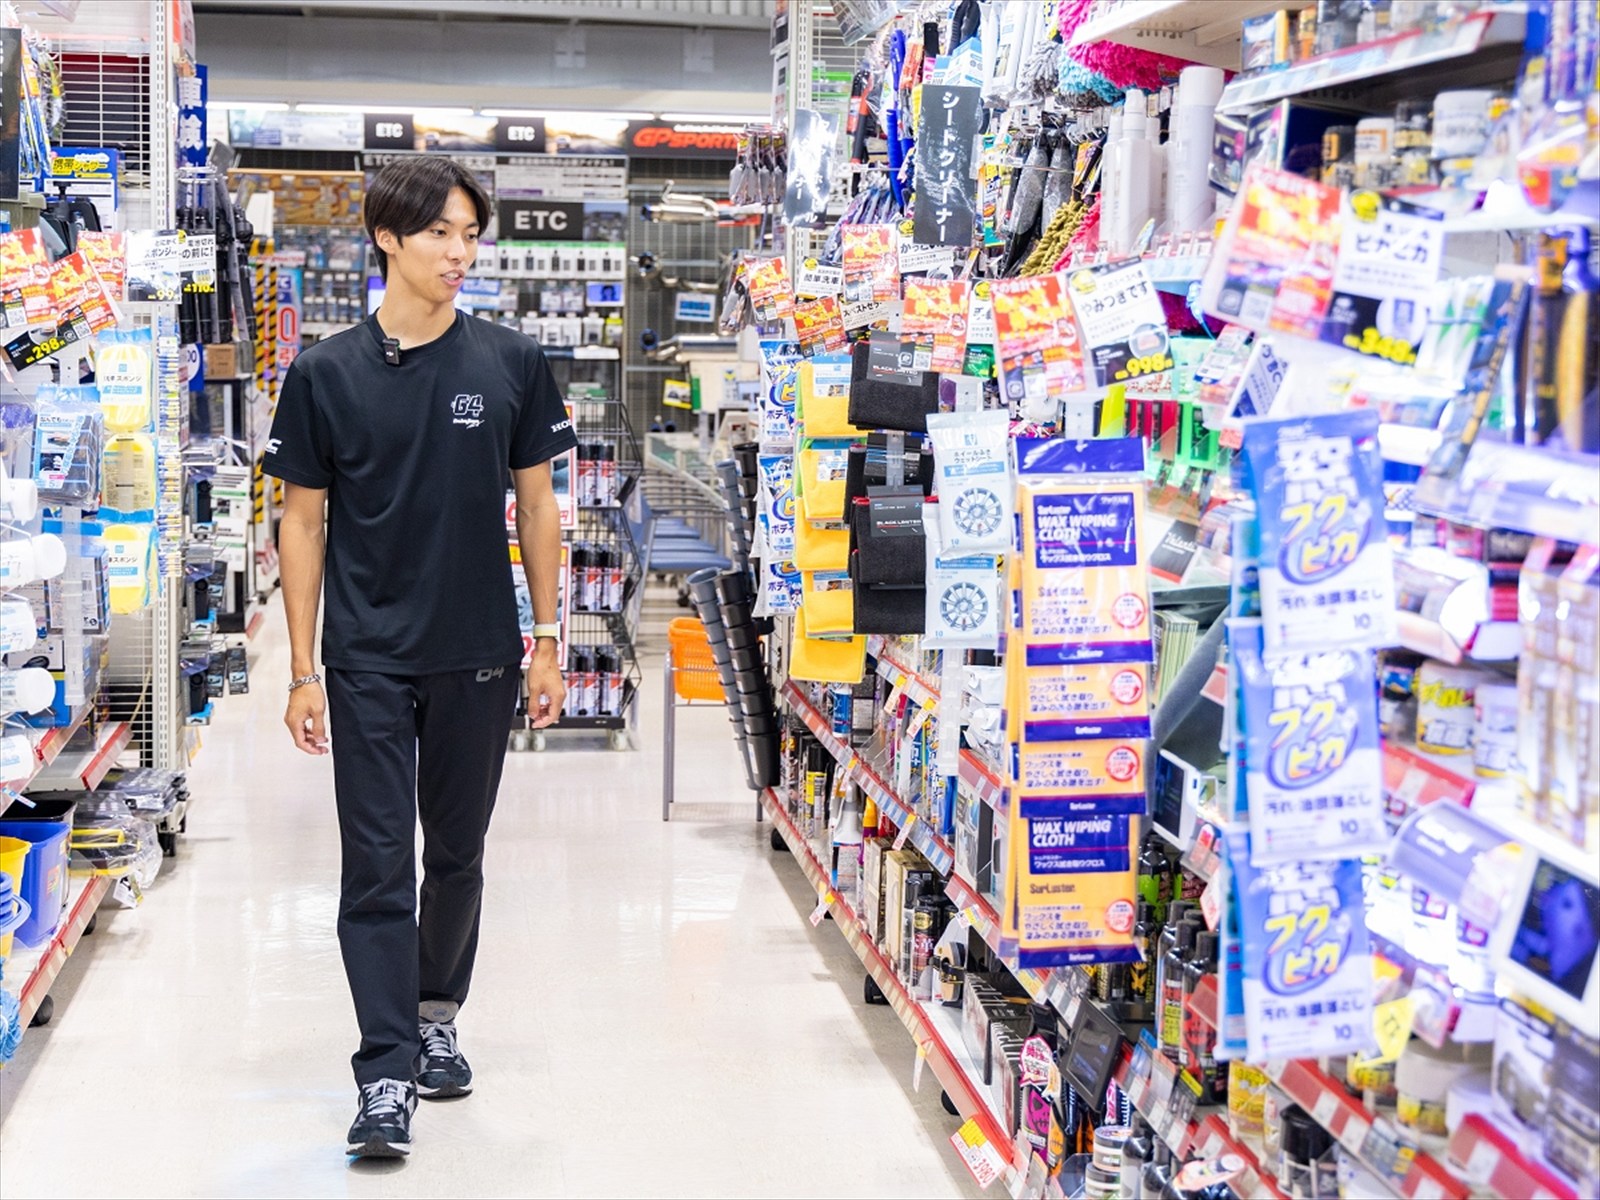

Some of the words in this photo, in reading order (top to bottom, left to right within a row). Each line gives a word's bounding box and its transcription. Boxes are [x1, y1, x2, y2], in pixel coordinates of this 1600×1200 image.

[375, 122, 403, 138] ETC
[507, 126, 535, 141] ETC
[934, 90, 961, 242] シートクリーナー
[514, 210, 568, 230] ETC
[1081, 280, 1148, 318] やみつきです
[1126, 352, 1166, 377] 998
[451, 394, 484, 417] G4
[1038, 515, 1068, 529] WAX
[1069, 513, 1117, 528] WIPING
[1038, 527, 1081, 542] CLOTH
[1280, 491, 1359, 575] フクピカ
[1030, 607, 1068, 615] ワックスを
[1031, 616, 1096, 625] やさしく拭き取り
[1353, 613, 1371, 629] 10
[1030, 684, 1066, 692] ワックスを
[1030, 693, 1094, 702] やさしく拭き取り
[1267, 697, 1346, 780] フクピカ
[1025, 760, 1062, 768] ワックスを
[1025, 769, 1089, 778] やさしく拭き取り
[1032, 821, 1061, 835] WAX
[1064, 820, 1112, 833] WIPING
[1340, 819, 1358, 834] 10
[1032, 834, 1075, 847] CLOTH
[1024, 912, 1061, 921] ワックスを
[1025, 921, 1089, 930] やさしく拭き取り
[1264, 904, 1341, 986] フクピカ
[1334, 1024, 1352, 1040] 10
